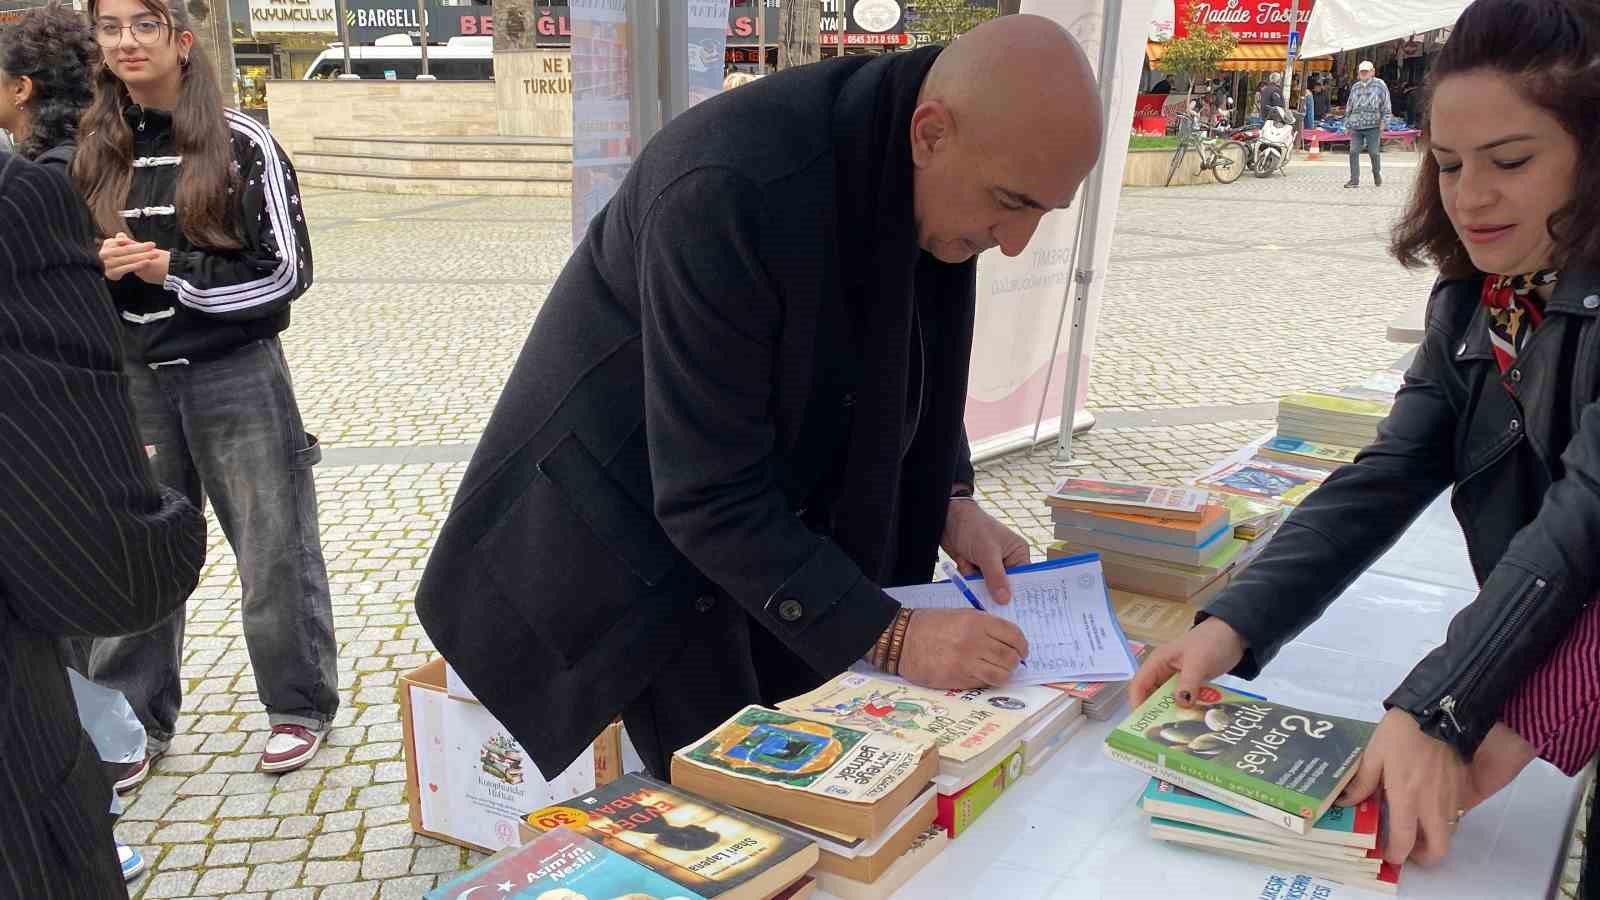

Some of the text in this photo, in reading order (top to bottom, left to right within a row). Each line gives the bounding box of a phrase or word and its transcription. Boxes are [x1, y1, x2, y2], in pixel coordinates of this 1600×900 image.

[251, 8, 334, 20] KUYUMCULUK
[543, 57, 562, 73] NE
[1236, 727, 1290, 776] şeyler
[1281, 714, 1334, 739] 2
[835, 744, 882, 781] yatmak
[537, 811, 578, 830] 30
